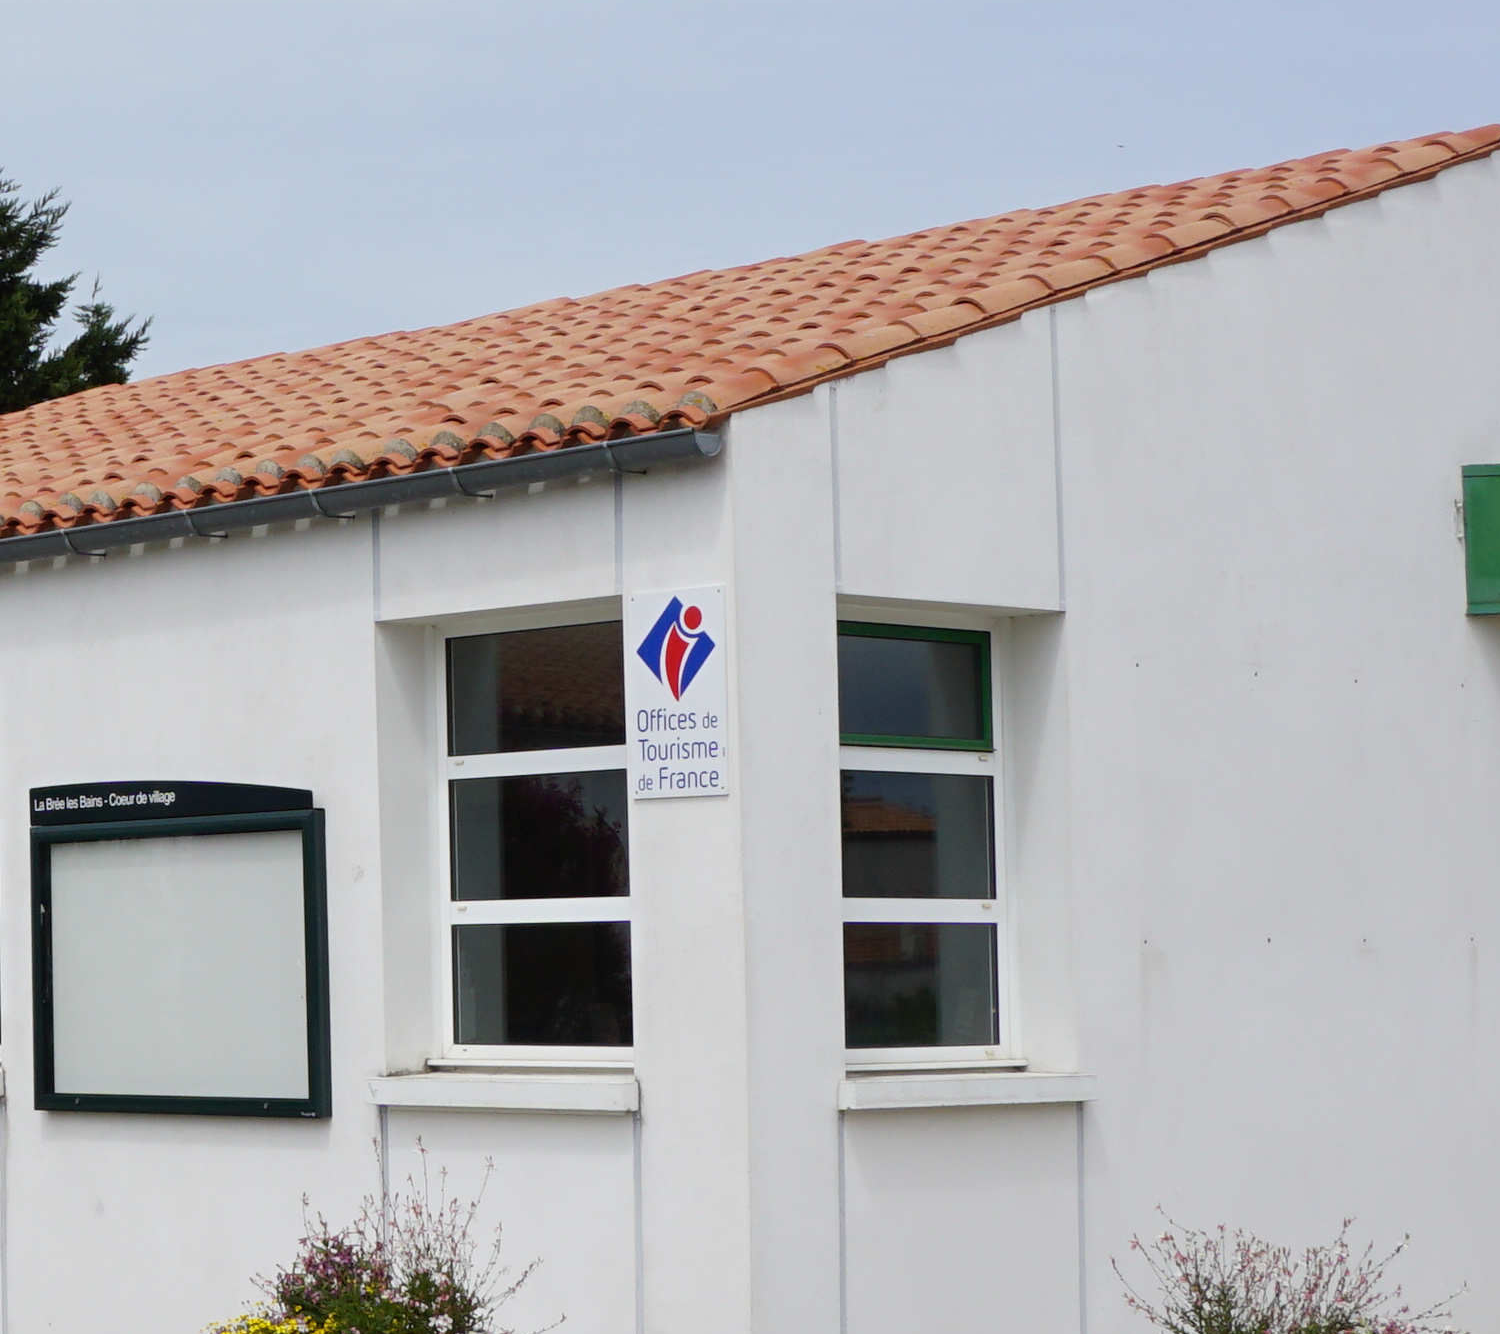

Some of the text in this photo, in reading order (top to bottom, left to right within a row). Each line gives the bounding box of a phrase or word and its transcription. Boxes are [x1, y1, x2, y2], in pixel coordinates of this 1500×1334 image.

[637, 708, 718, 732] Offices de
[638, 737, 718, 762] Tourisme
[638, 767, 719, 791] de France
[34, 799, 45, 812] La
[46, 797, 65, 810] Brée
[66, 796, 78, 809] les
[79, 795, 103, 808] Bains
[108, 792, 135, 807] Coeur
[135, 791, 147, 805] de
[148, 790, 175, 806] village
